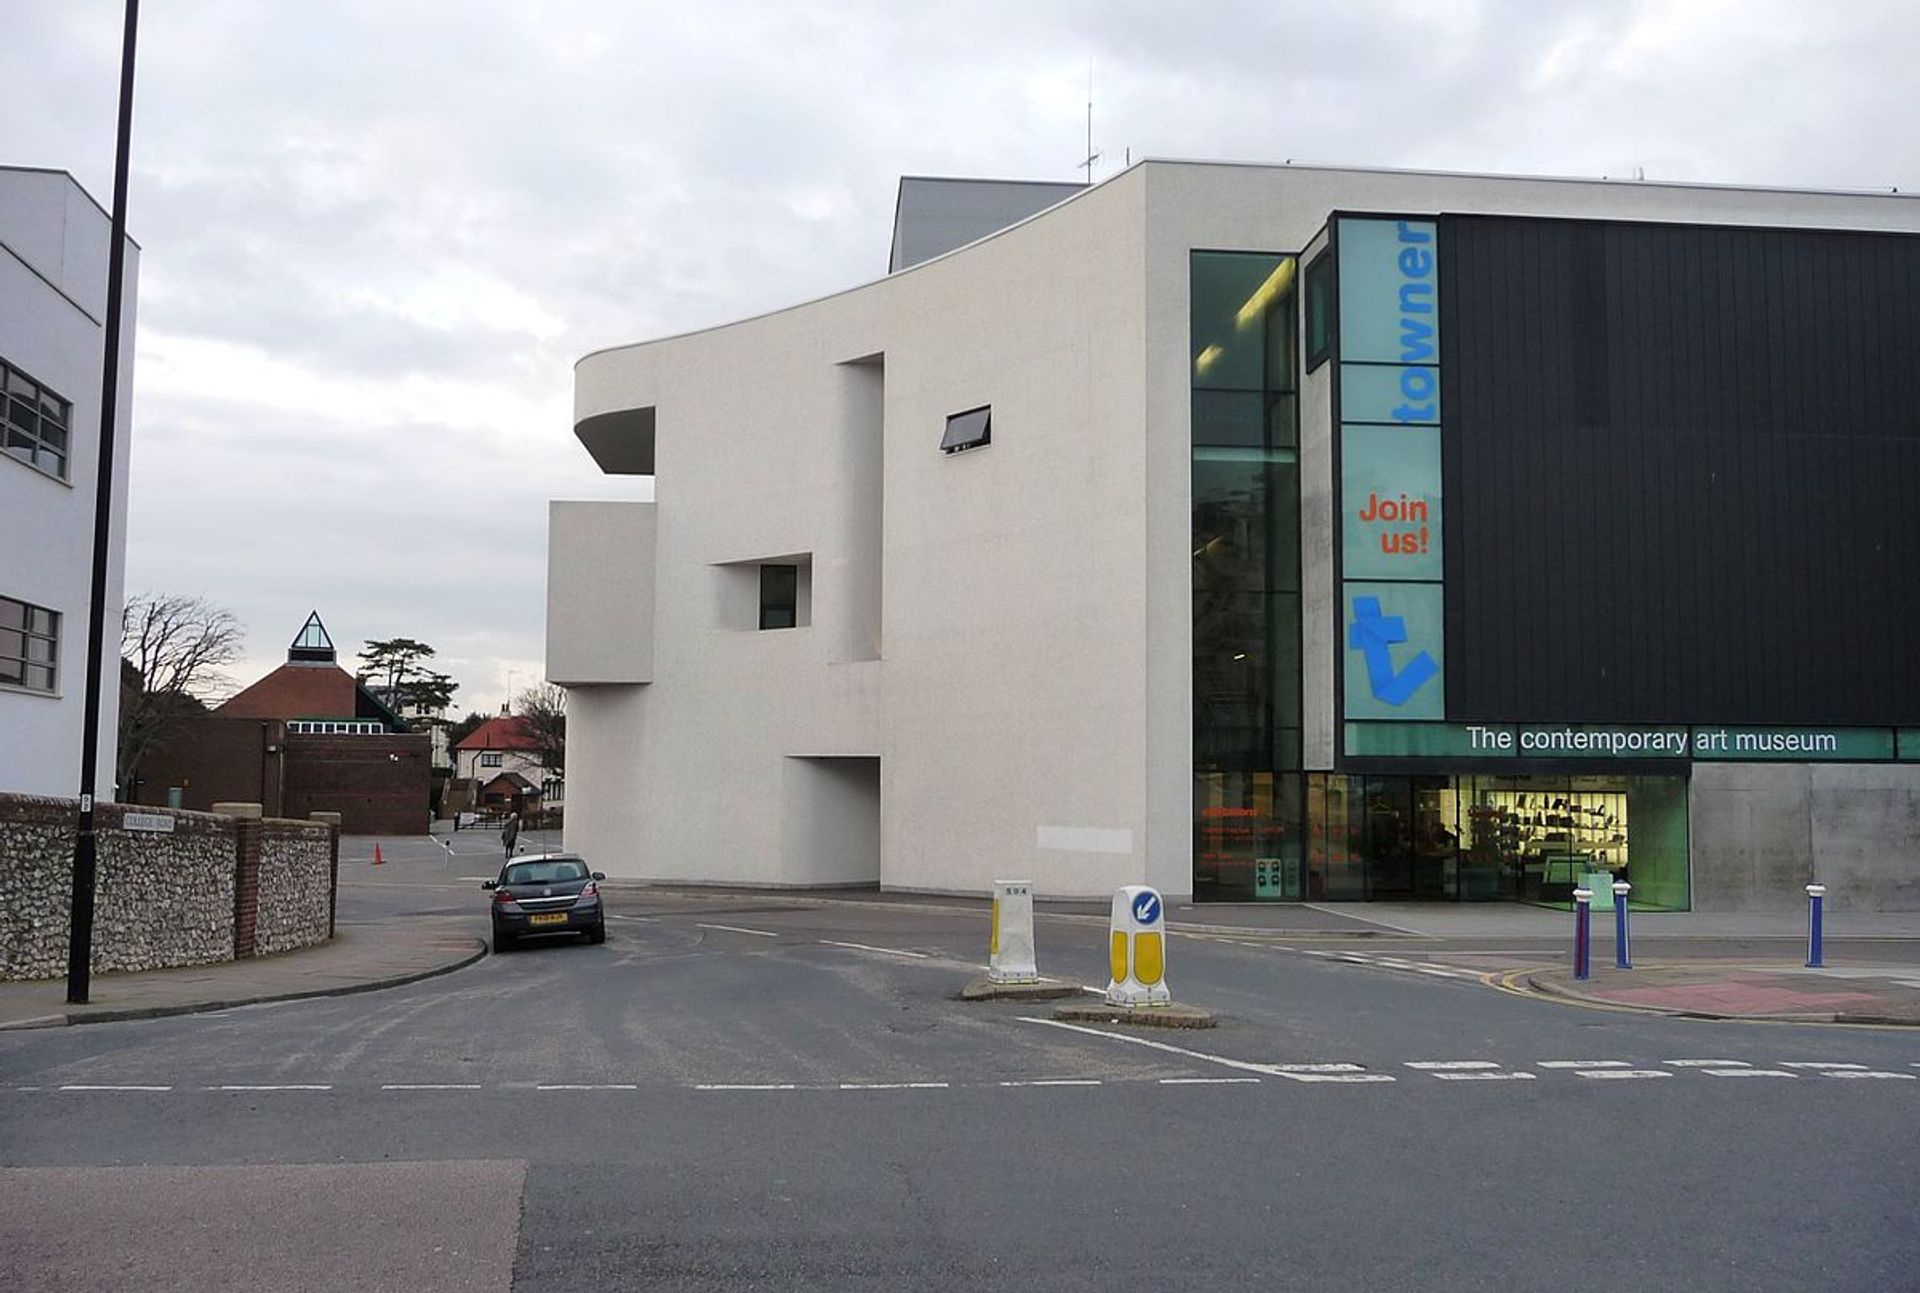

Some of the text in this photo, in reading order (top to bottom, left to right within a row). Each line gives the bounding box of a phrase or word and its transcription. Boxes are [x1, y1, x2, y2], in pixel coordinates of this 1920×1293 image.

[1392, 220, 1436, 423] towner
[1359, 492, 1428, 522] Join
[1380, 526, 1429, 555] us!
[1466, 726, 1837, 755] The contemporary art museum
